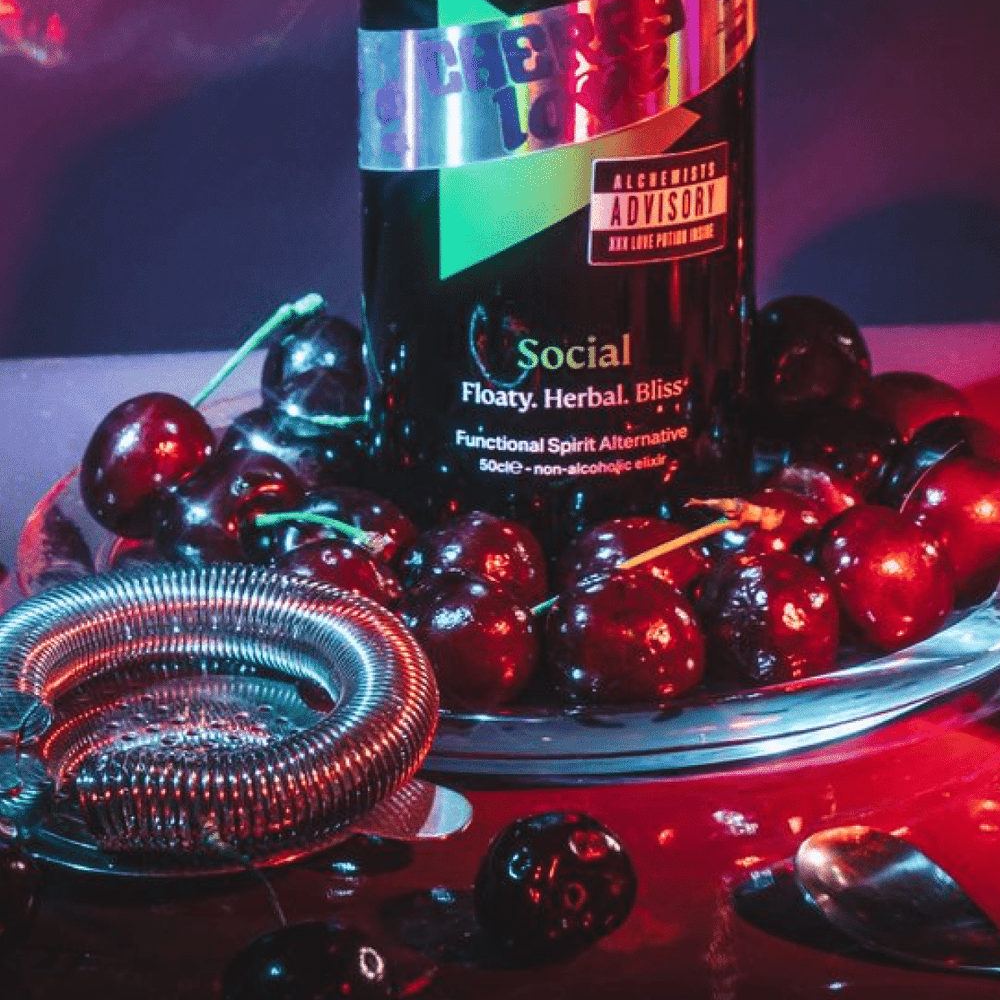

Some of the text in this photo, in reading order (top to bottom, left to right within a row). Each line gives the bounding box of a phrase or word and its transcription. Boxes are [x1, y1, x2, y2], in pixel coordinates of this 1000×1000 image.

[612, 160, 716, 191] ALCHEMISTS
[610, 183, 716, 227] ADVISORY
[630, 233, 654, 250] LOVE
[656, 228, 687, 248] POTION
[516, 333, 632, 370] Social
[461, 381, 538, 413] Floaty.
[544, 383, 629, 409] Herbal.
[455, 426, 689, 456] Functional Spirit Alternative
[533, 460, 632, 476] non-alcoholic
[634, 452, 668, 470] elixir
